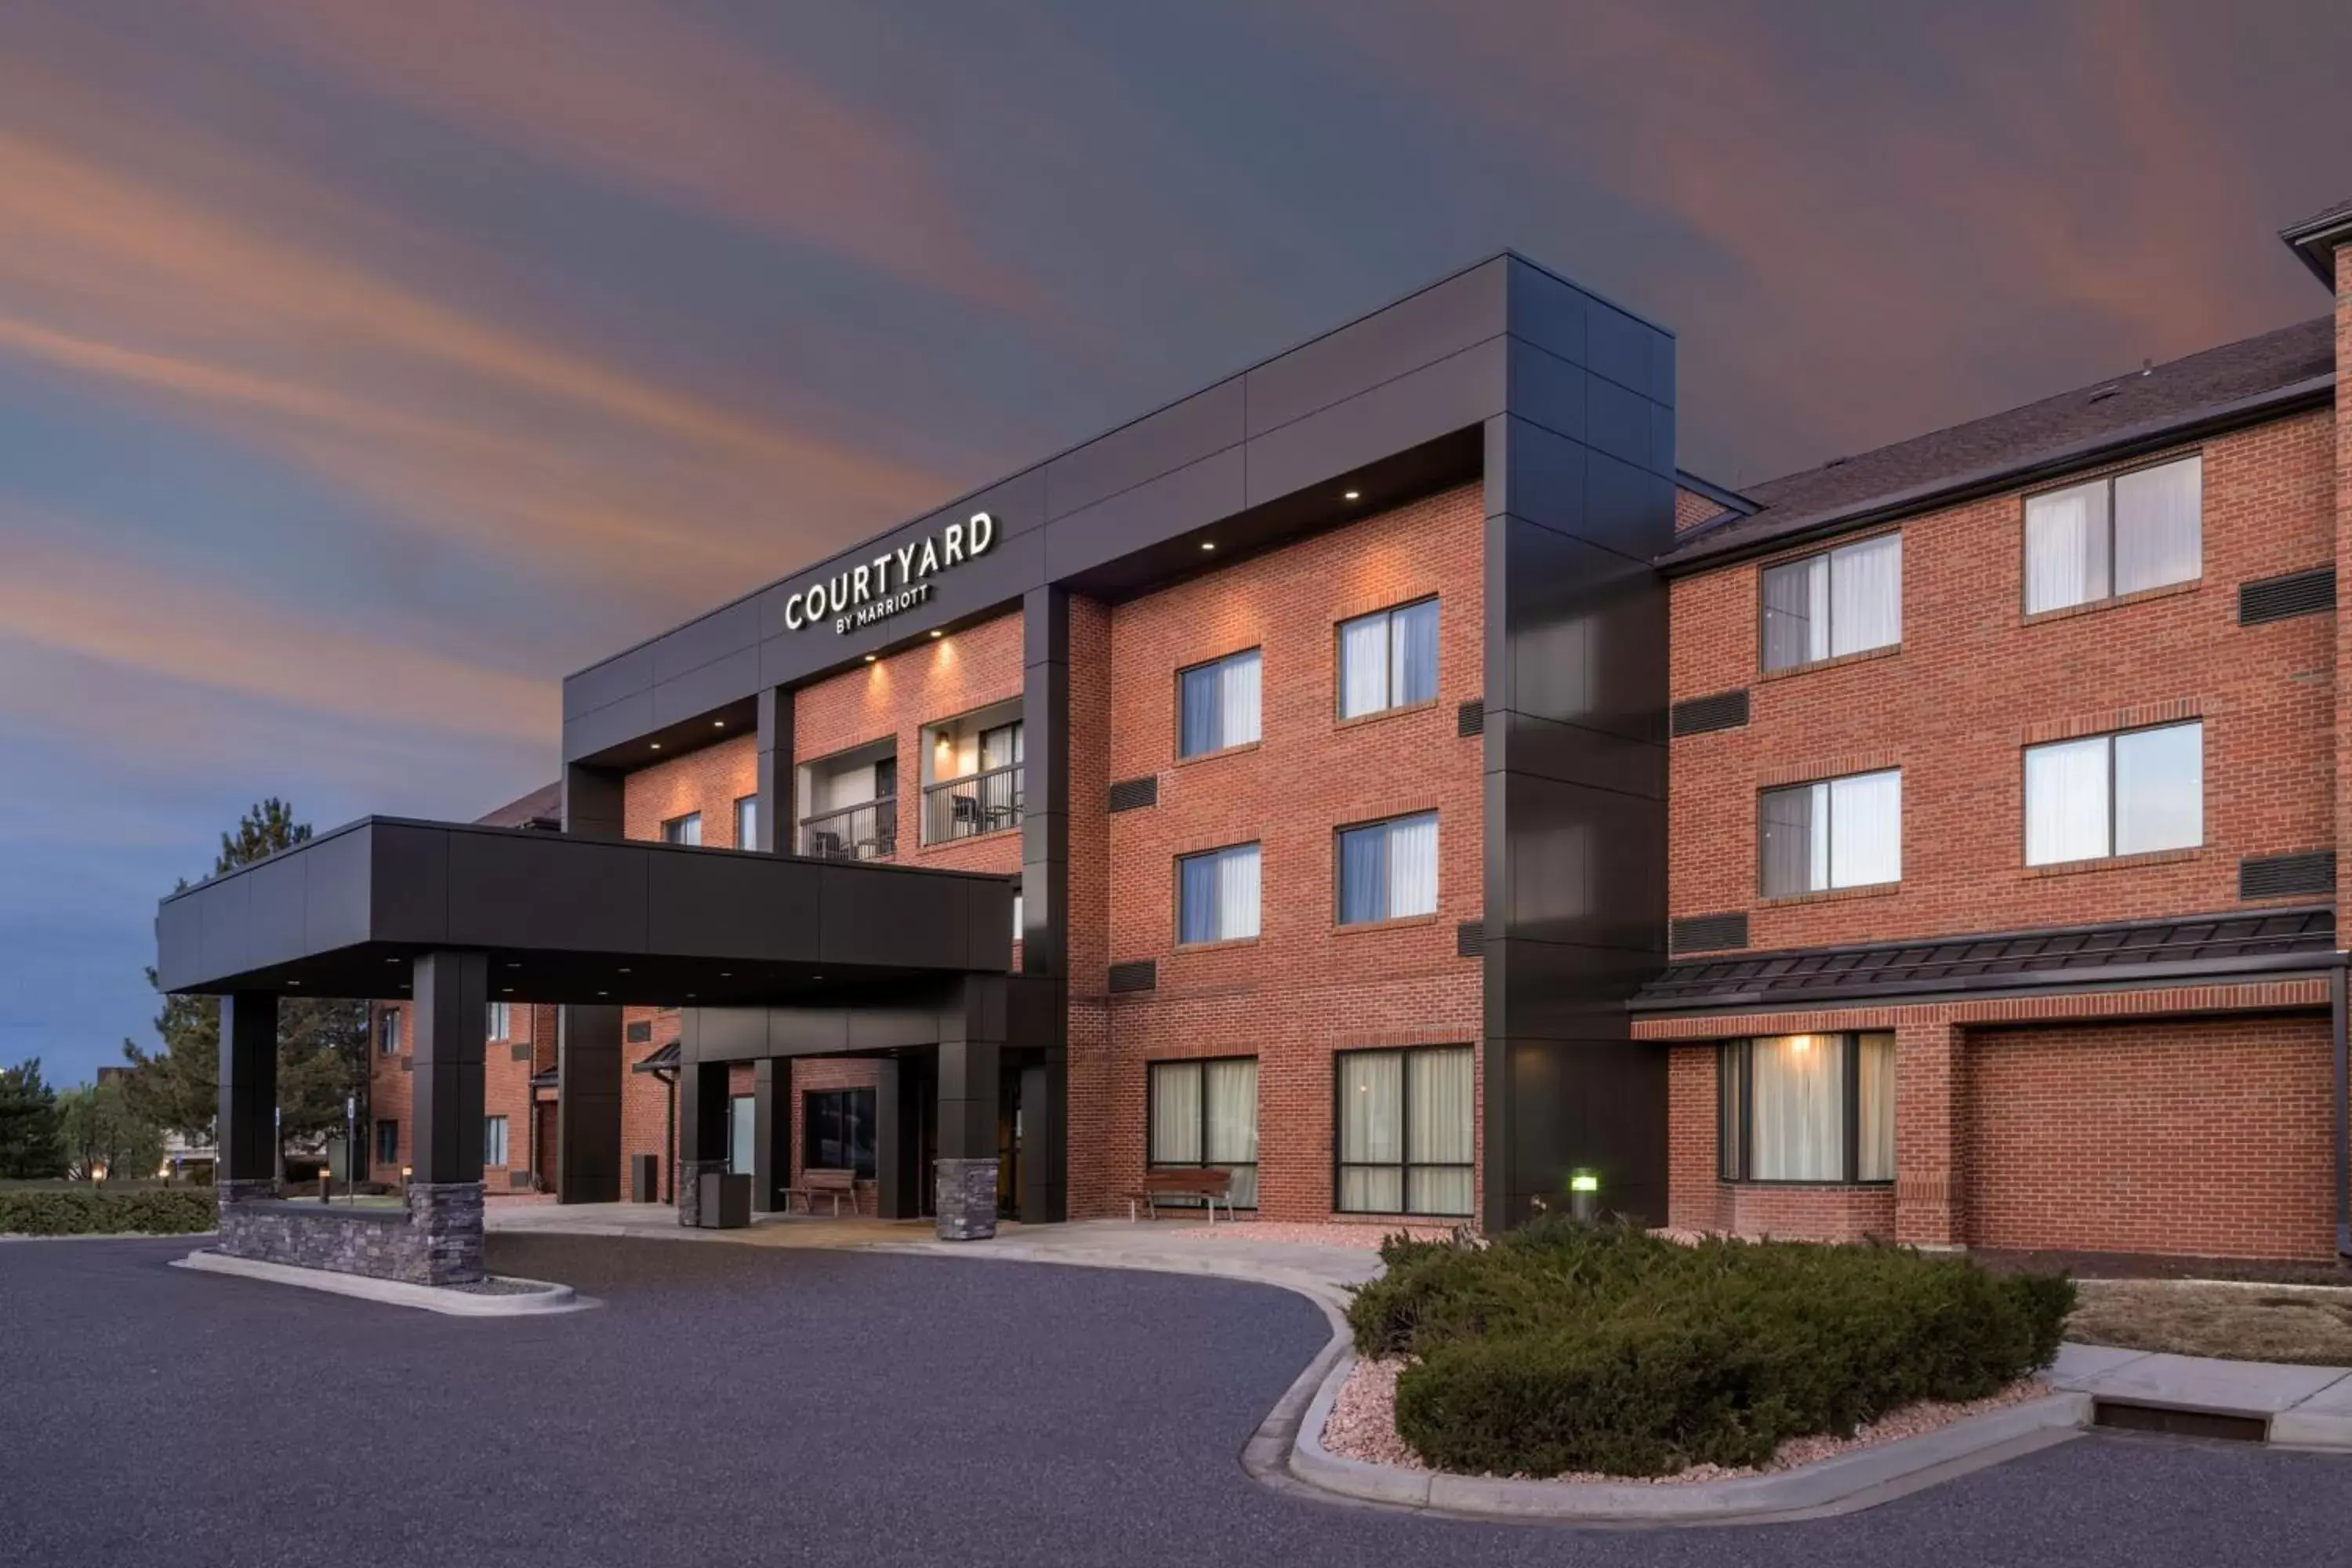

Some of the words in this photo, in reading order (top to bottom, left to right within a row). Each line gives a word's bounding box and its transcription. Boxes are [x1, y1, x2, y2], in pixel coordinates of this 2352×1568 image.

[786, 512, 992, 630] COURTYARD
[837, 615, 852, 634] BY
[857, 584, 928, 626] MARRIOTT
